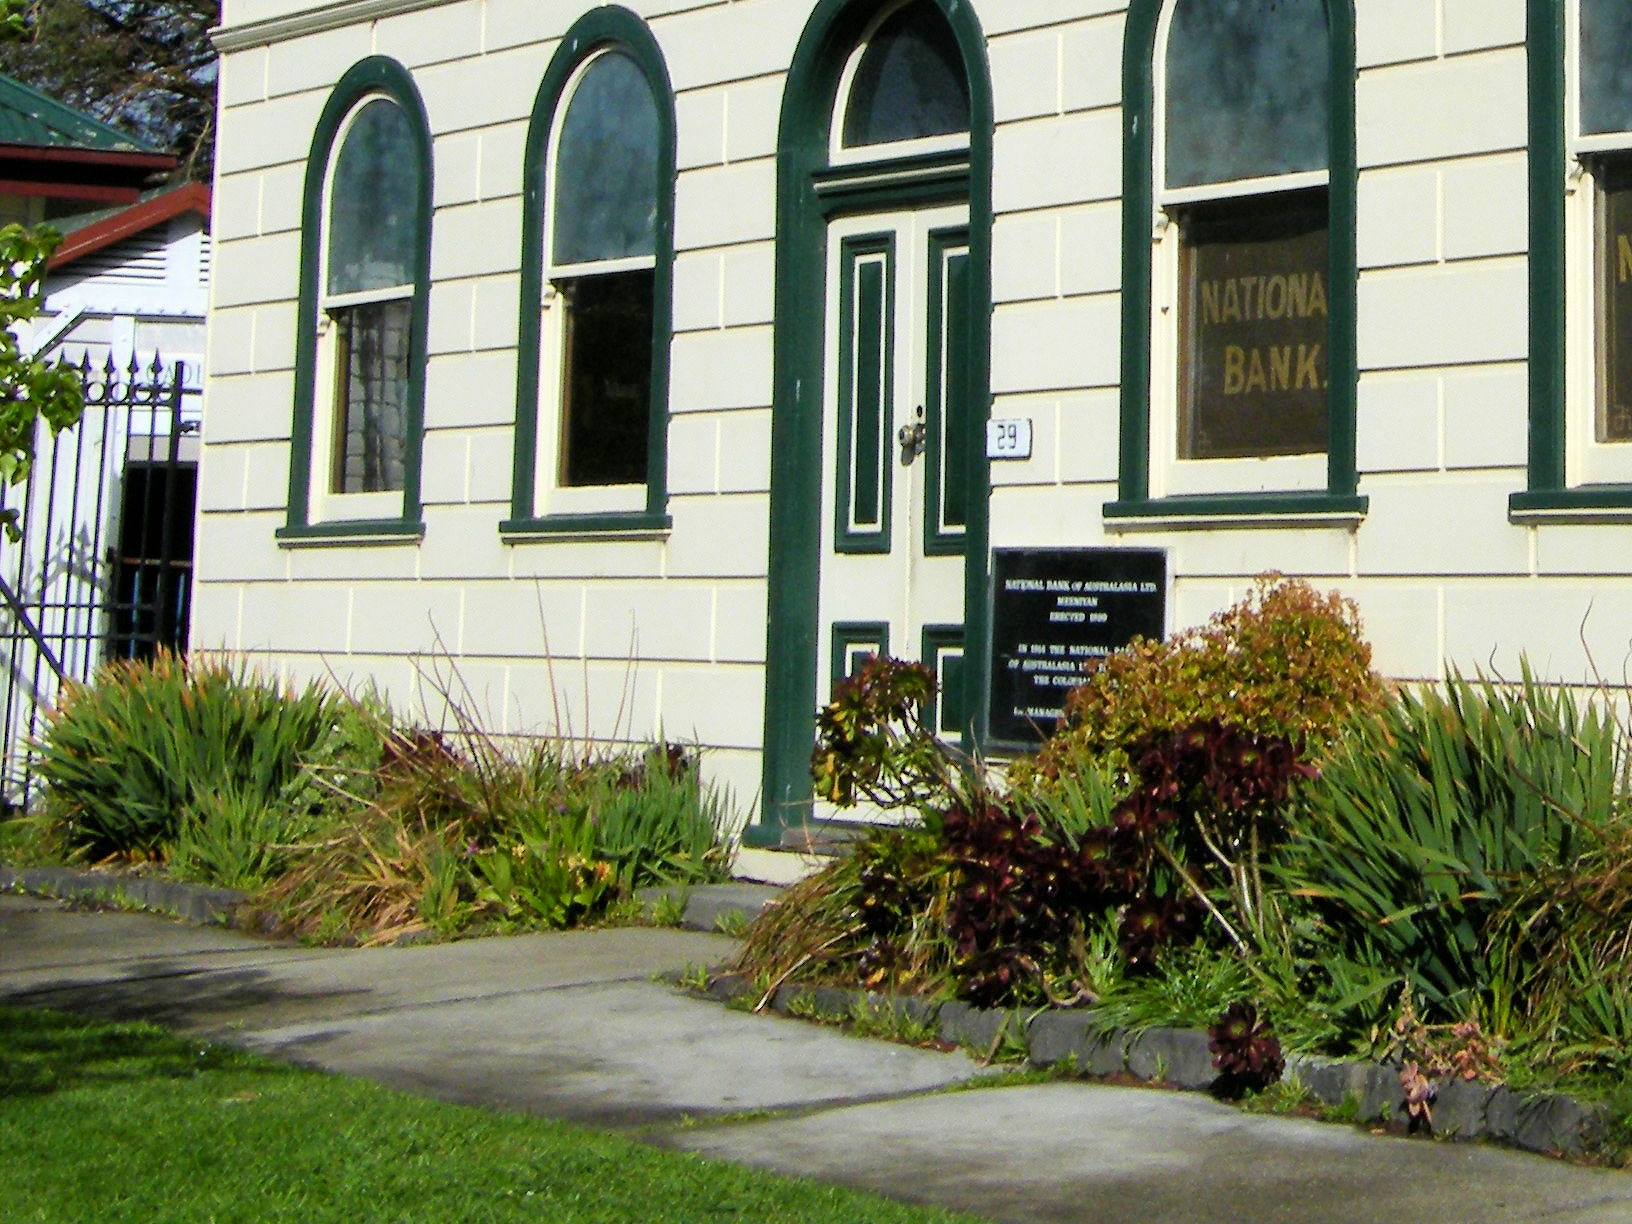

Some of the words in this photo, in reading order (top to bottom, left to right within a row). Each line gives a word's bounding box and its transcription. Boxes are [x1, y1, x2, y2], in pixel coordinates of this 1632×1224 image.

[1201, 271, 1328, 325] NATIONA
[997, 424, 1017, 450] 29
[1005, 579, 1045, 591] NATIONAL
[1046, 580, 1070, 592] BANK
[1071, 581, 1083, 592] OF
[1083, 581, 1138, 593] AUSTRALASIA
[1049, 644, 1066, 655] THE
